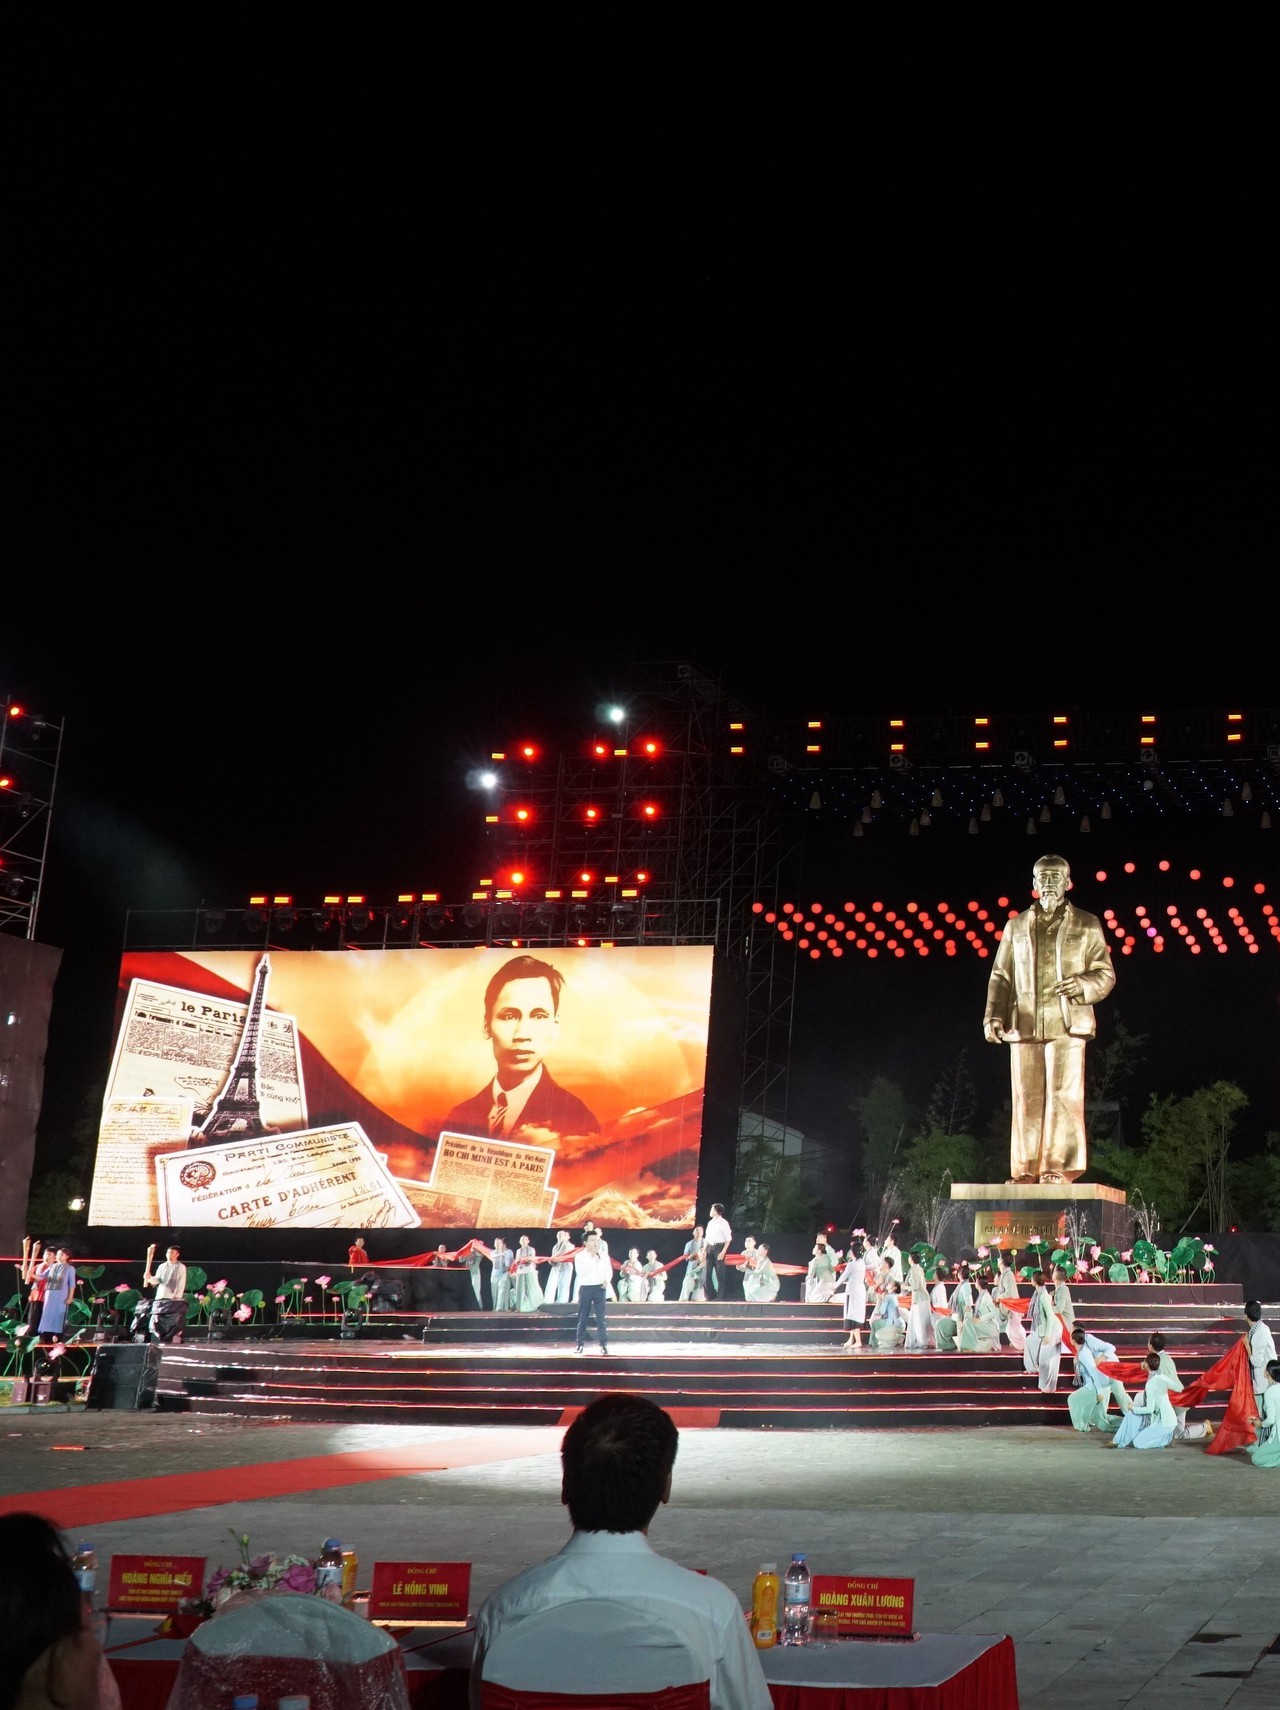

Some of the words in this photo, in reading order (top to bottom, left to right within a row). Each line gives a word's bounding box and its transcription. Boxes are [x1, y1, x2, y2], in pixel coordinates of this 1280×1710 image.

[224, 1147, 269, 1162] PARTI
[275, 1132, 350, 1151] COMMUNISTE
[443, 1148, 455, 1157] HO
[456, 1150, 470, 1159] CHI
[471, 1153, 493, 1164] MINH
[494, 1157, 510, 1167] EST
[519, 1163, 544, 1173] PARIS
[217, 1195, 273, 1220] CARTE
[278, 1171, 358, 1203] D'ADHÉRENT
[121, 1570, 148, 1585] HOÀNG
[392, 1581, 403, 1595] LÊ
[404, 1580, 427, 1596] HỒNG
[428, 1583, 449, 1596] VINH
[819, 1590, 849, 1606] HOÀNG
[850, 1592, 875, 1607] XUÂN
[876, 1593, 905, 1608] LƯƠNG
